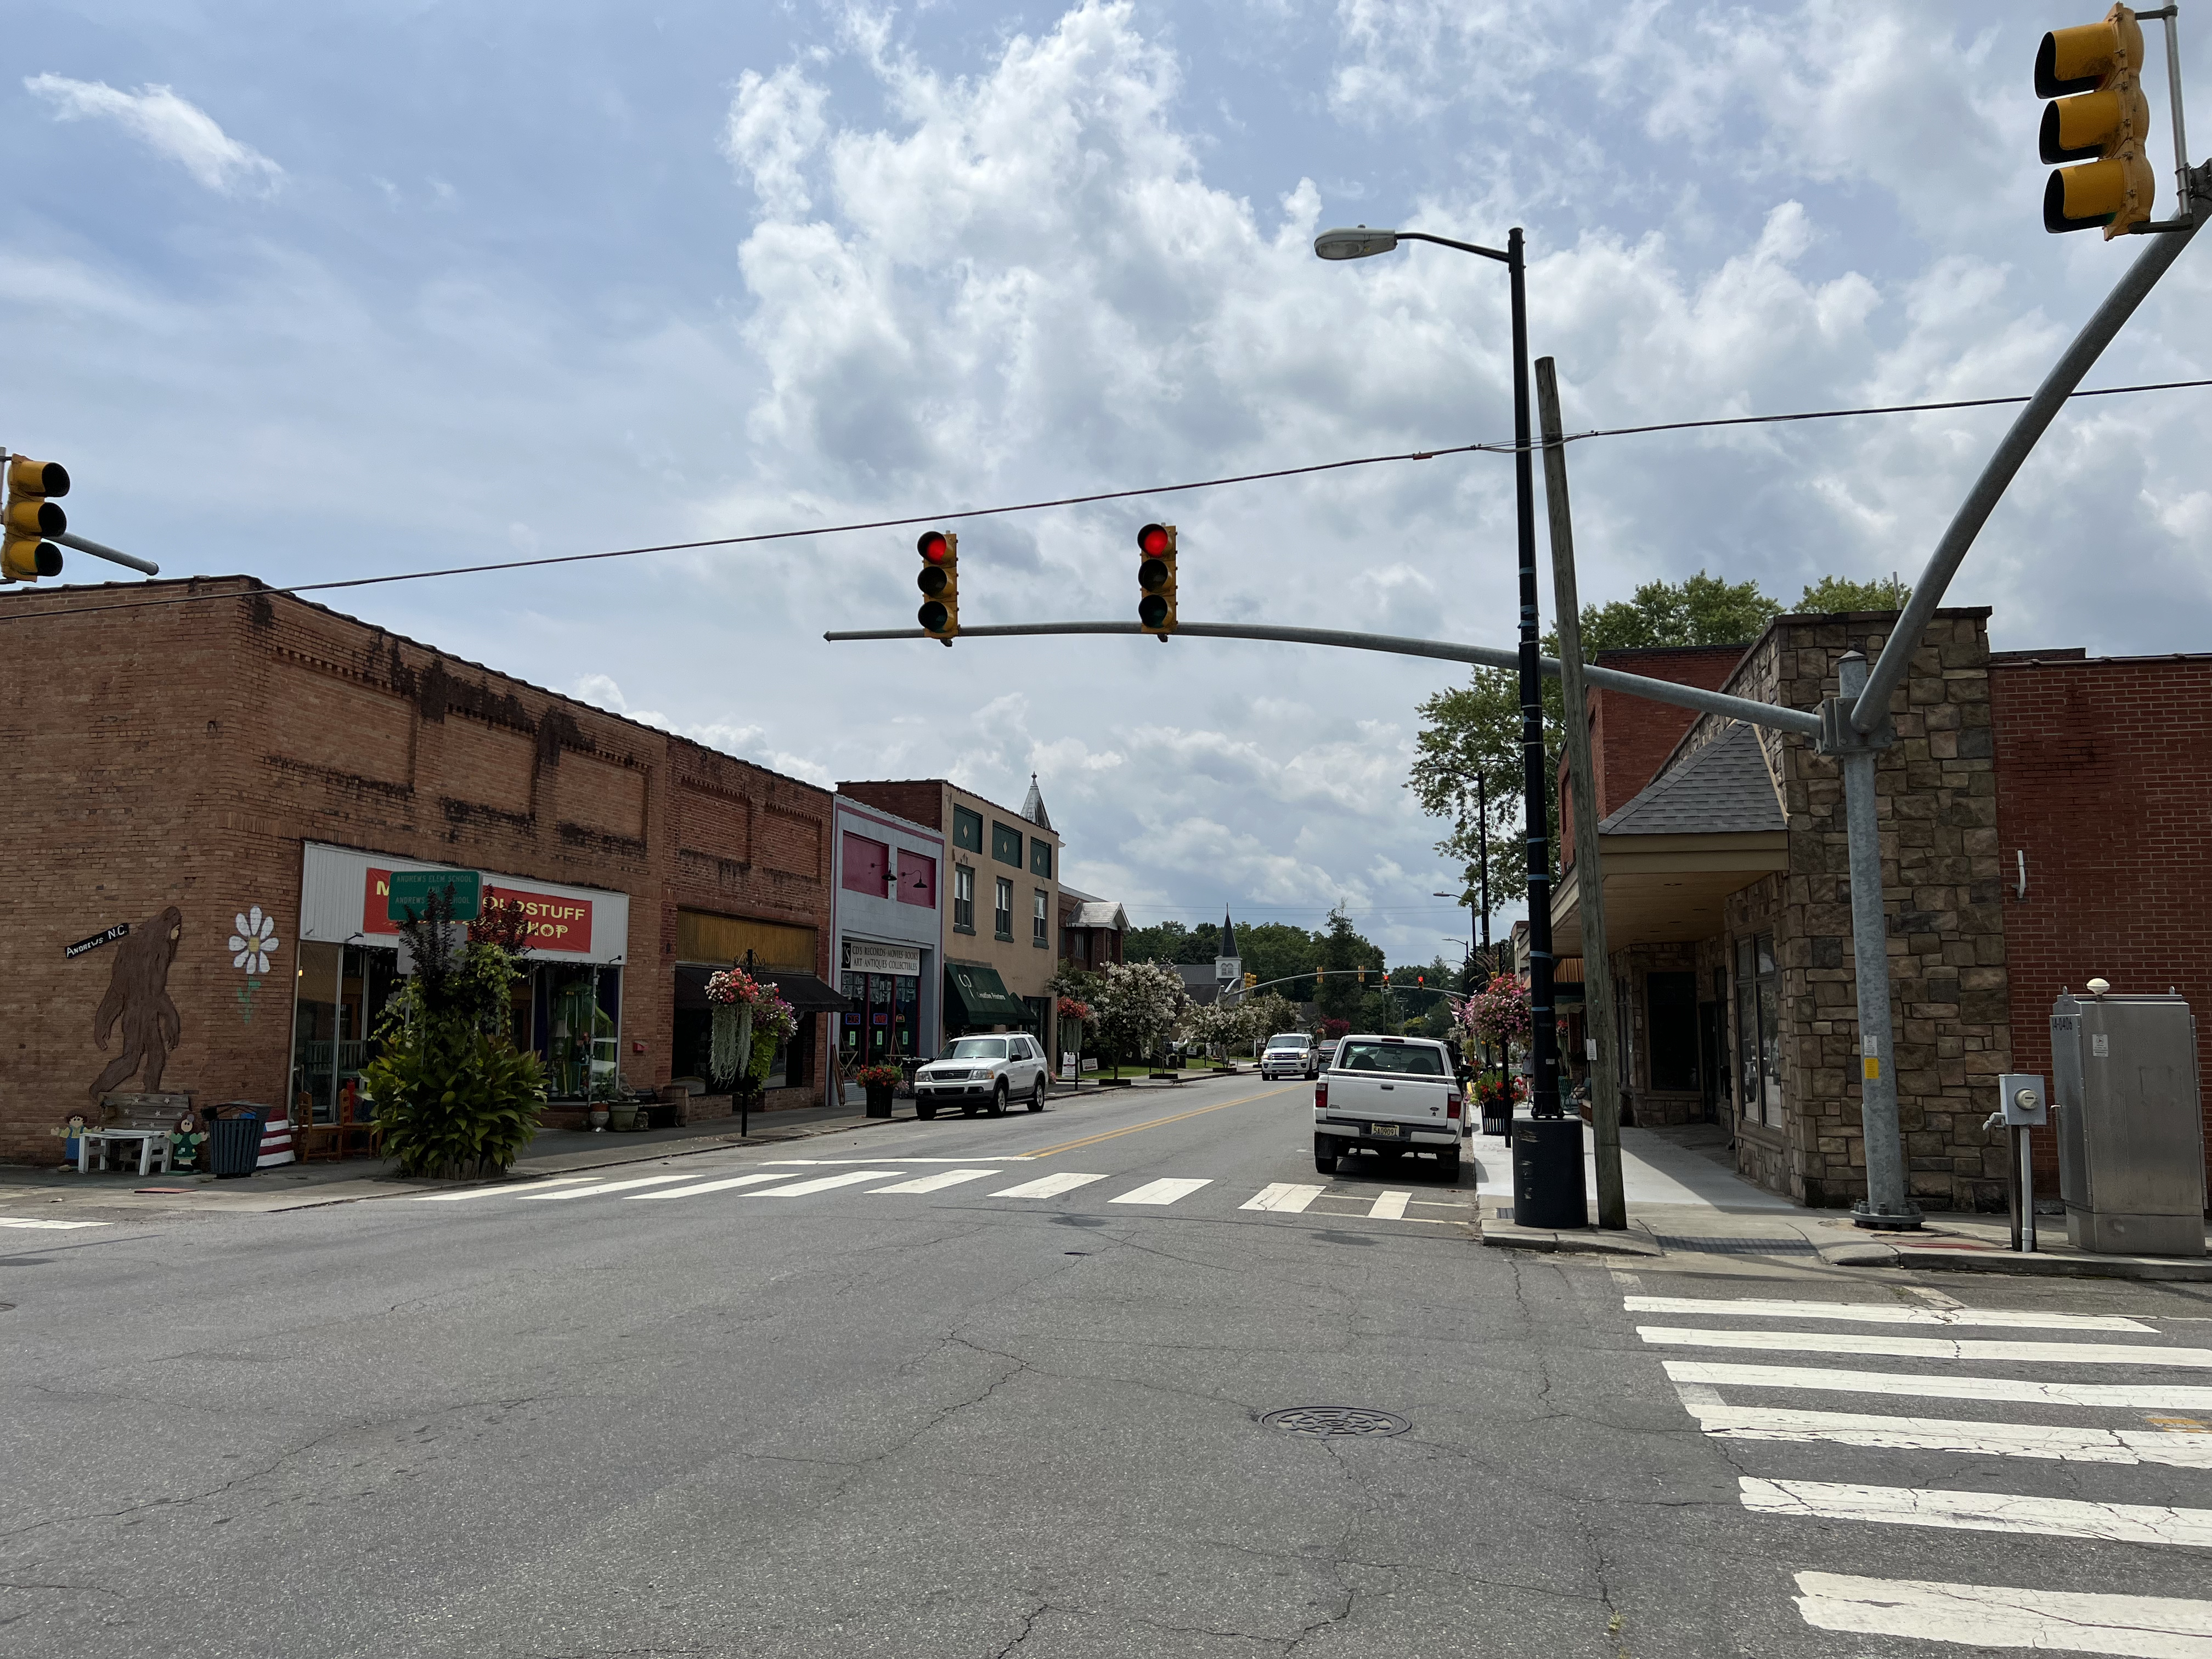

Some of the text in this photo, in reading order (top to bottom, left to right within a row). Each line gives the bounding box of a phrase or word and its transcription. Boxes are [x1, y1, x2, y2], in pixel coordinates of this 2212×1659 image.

[852, 946, 862, 955] CD'S
[865, 947, 885, 956] RECORDS
[905, 951, 918, 960] BOOKS
[854, 958, 917, 970] ART ANTIQUES COLLECTIBLES
